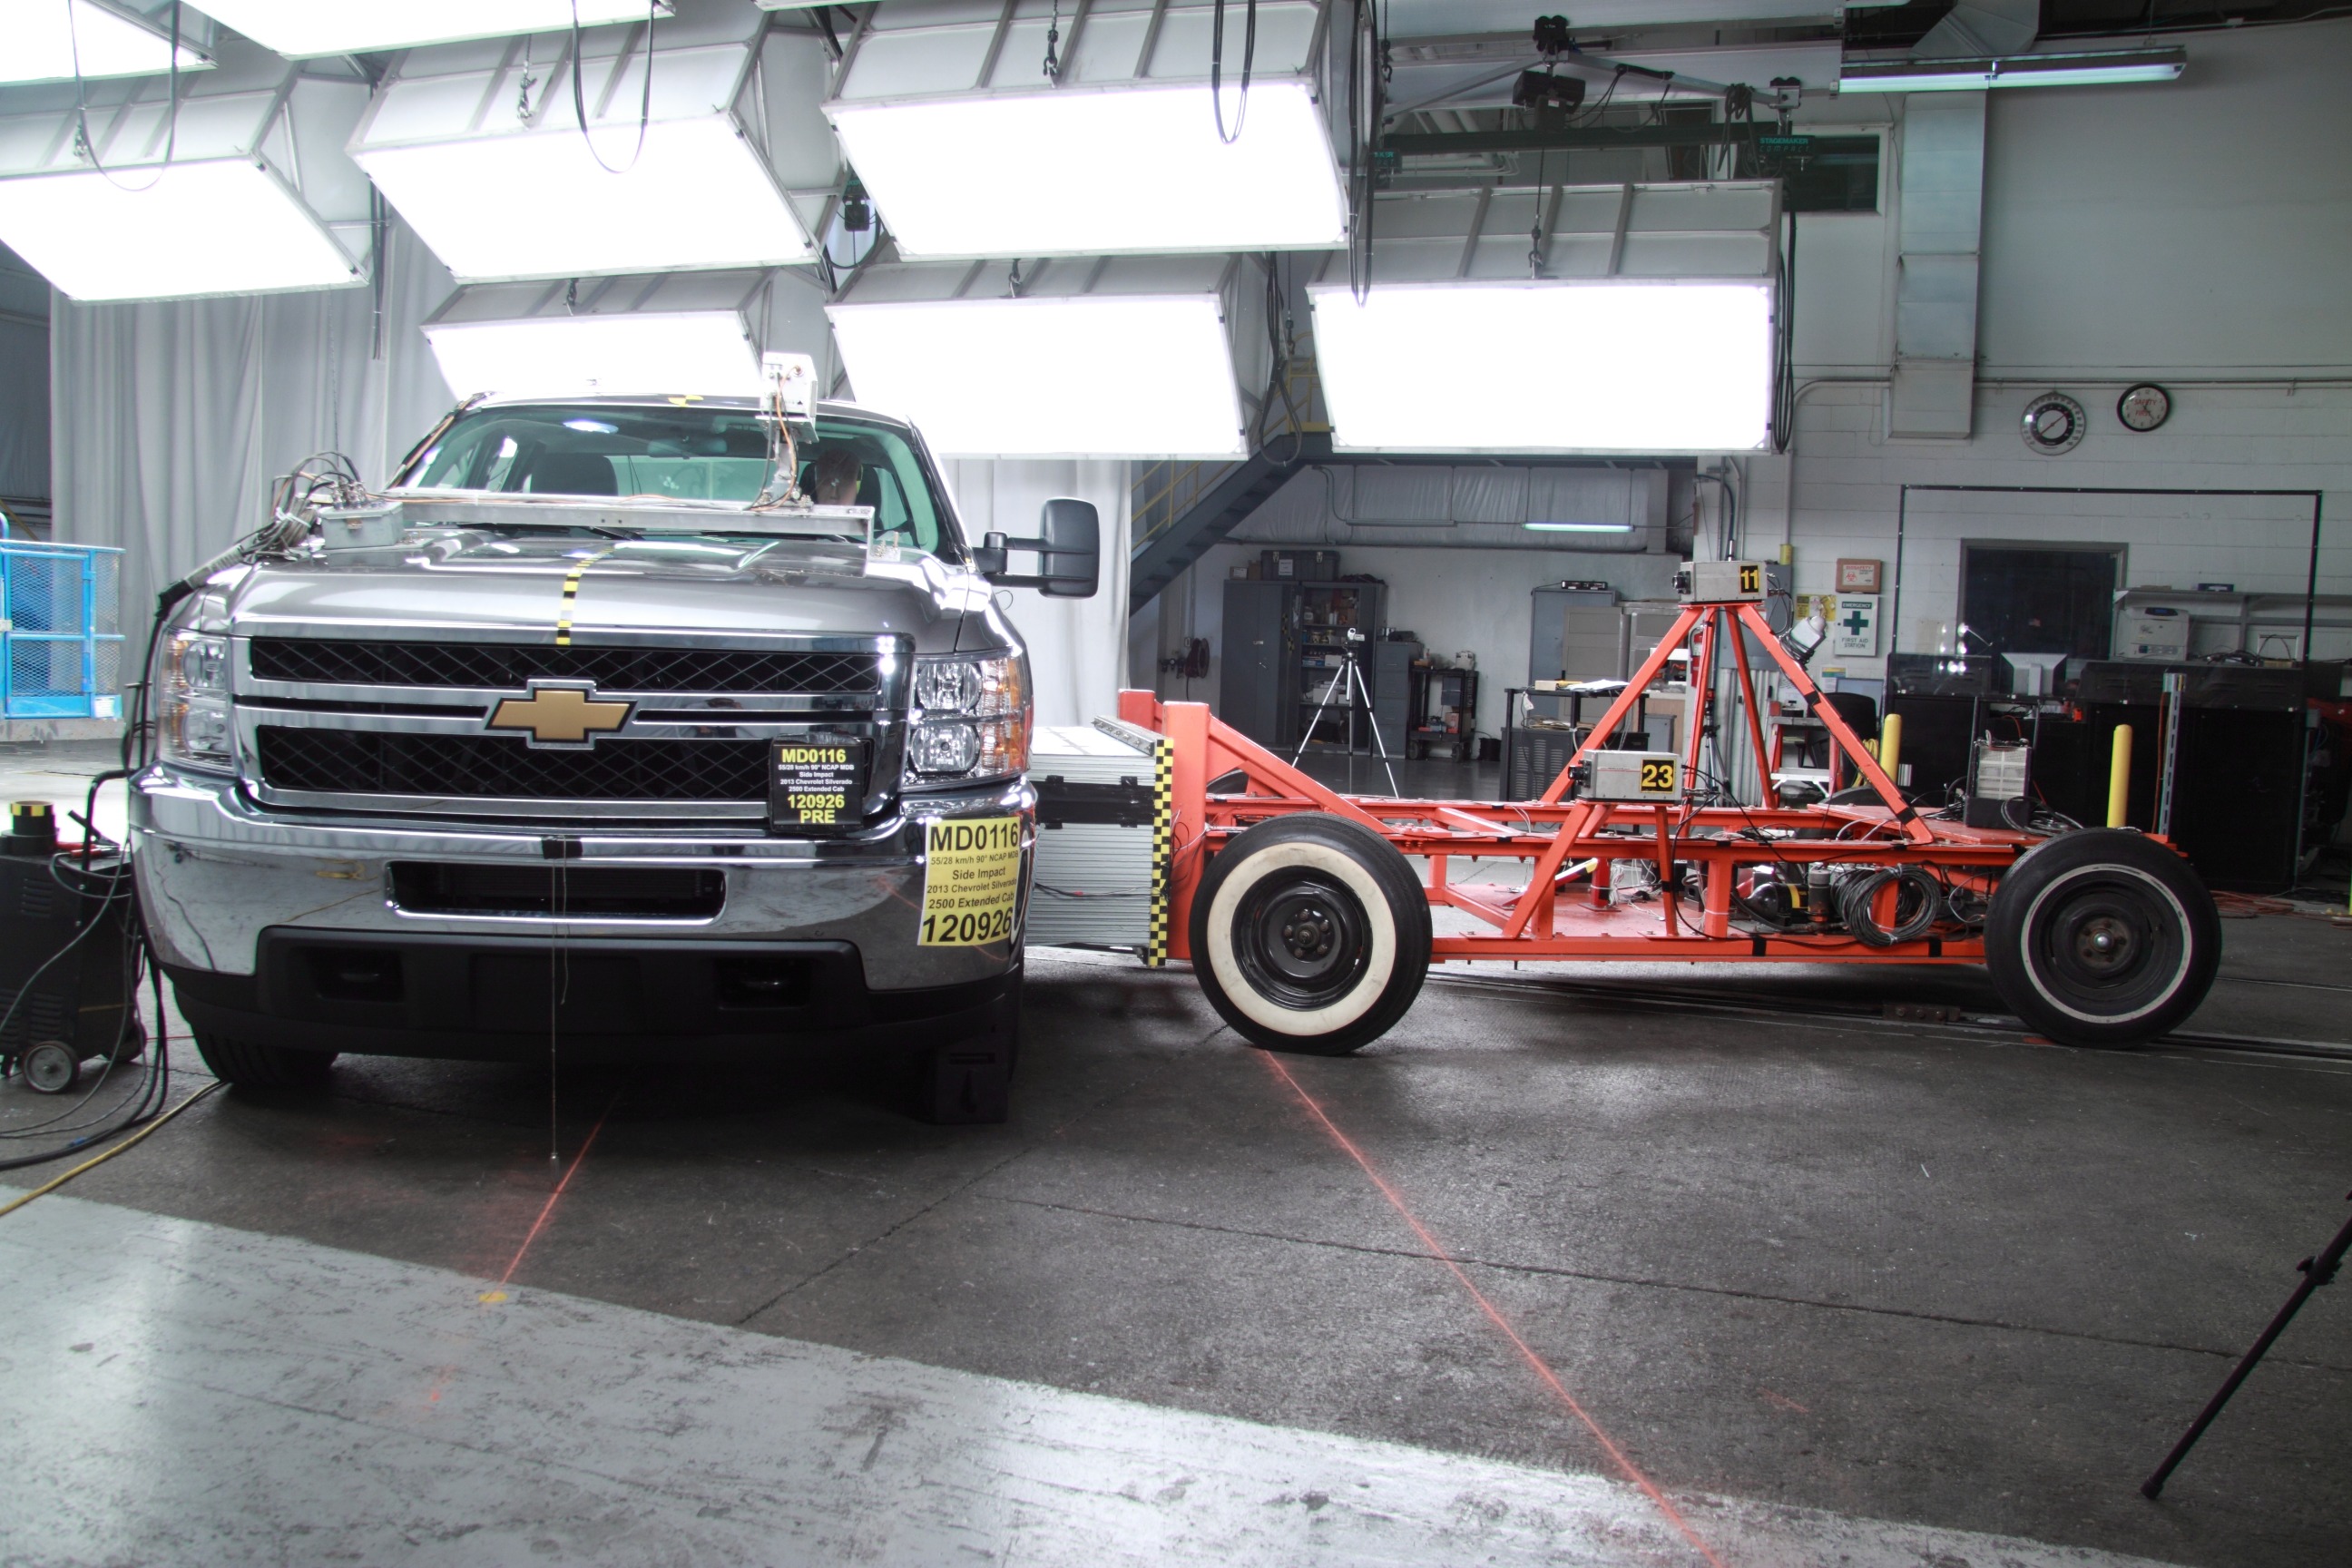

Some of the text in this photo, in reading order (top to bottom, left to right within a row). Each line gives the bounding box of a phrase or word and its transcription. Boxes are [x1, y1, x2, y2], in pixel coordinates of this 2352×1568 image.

[1741, 569, 1759, 589] 11
[782, 749, 846, 763] MD0116
[1642, 764, 1673, 788] 23
[788, 794, 845, 808] 120926
[800, 810, 836, 823] PRE
[930, 823, 1019, 851] MD0116
[989, 853, 1006, 862] NCAP
[1008, 850, 1019, 859] MDB
[952, 867, 1006, 881] Side Impact
[951, 883, 990, 893] Chevrolet
[991, 878, 1017, 889] Silverado
[929, 892, 1014, 909] 2500 Extended Cab
[923, 906, 1013, 942] 120926
